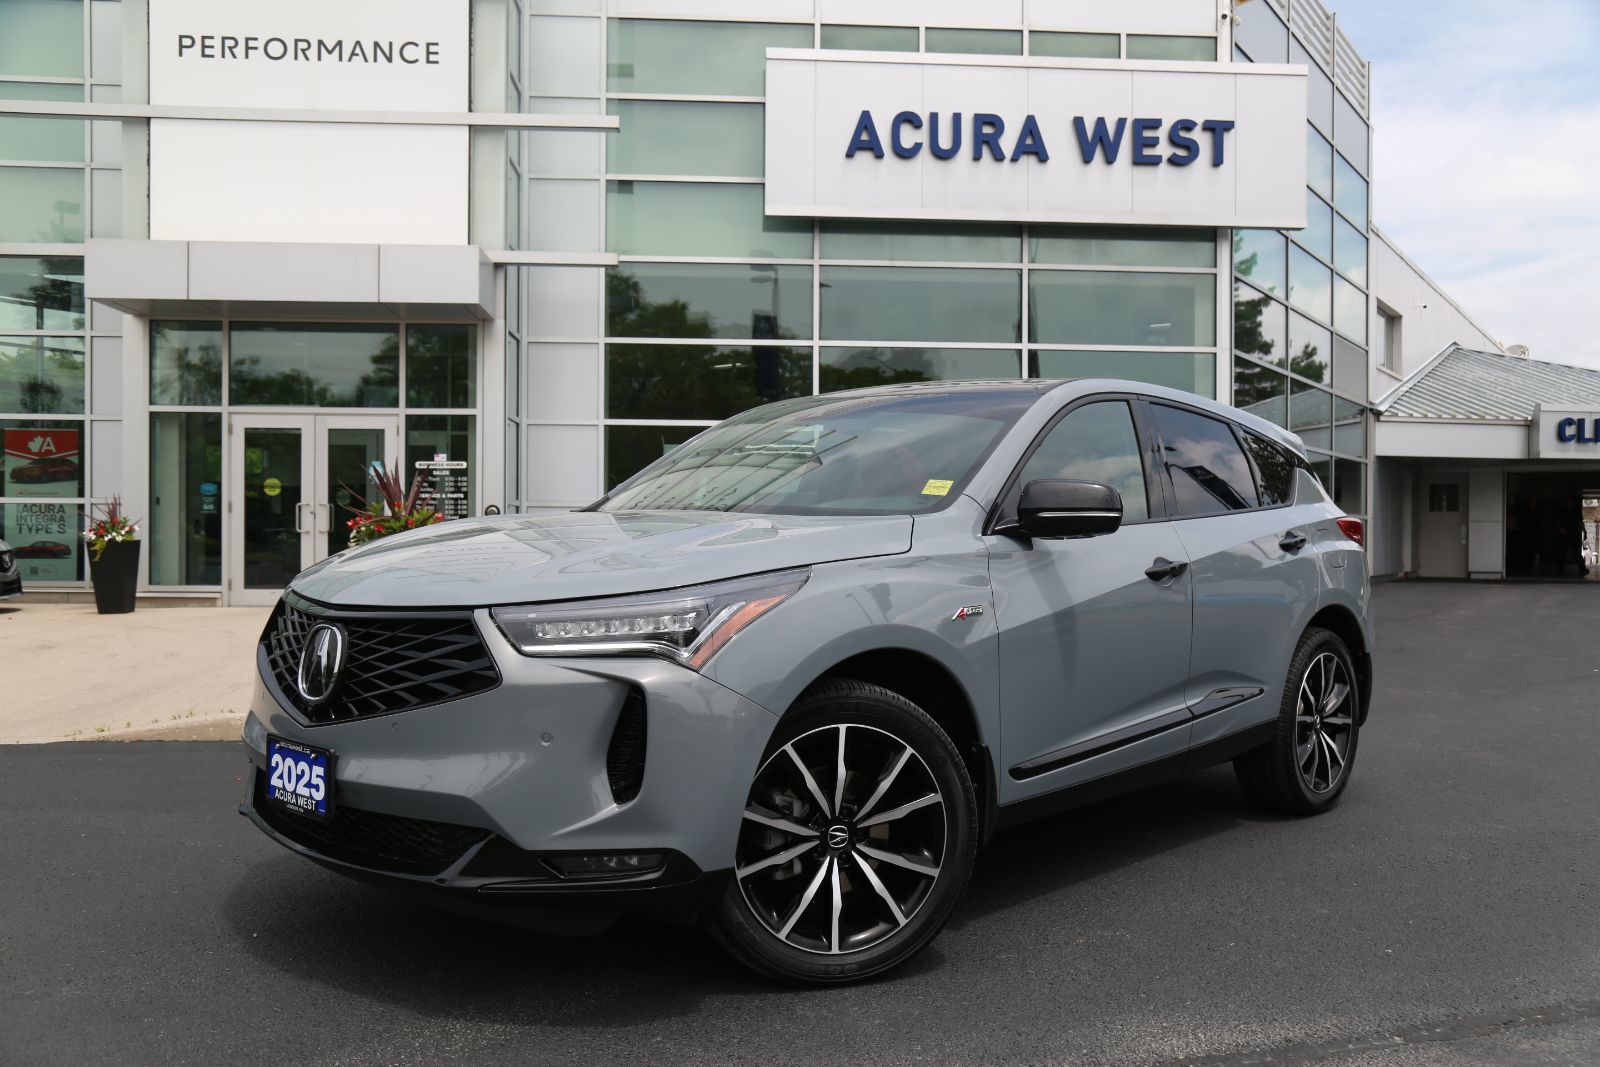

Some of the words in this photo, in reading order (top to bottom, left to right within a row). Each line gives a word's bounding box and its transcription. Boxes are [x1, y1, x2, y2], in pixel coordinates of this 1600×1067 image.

[178, 34, 440, 65] PERFORMANCE
[845, 110, 1050, 162] ACURA
[1073, 116, 1235, 168] WEST
[16, 514, 66, 524] INTEGRA
[21, 504, 66, 514] ACURA
[16, 524, 54, 535] TYPE
[57, 524, 66, 535] S
[270, 753, 326, 801] 2025
[274, 788, 297, 805] ACURA
[297, 796, 317, 811] WEST
